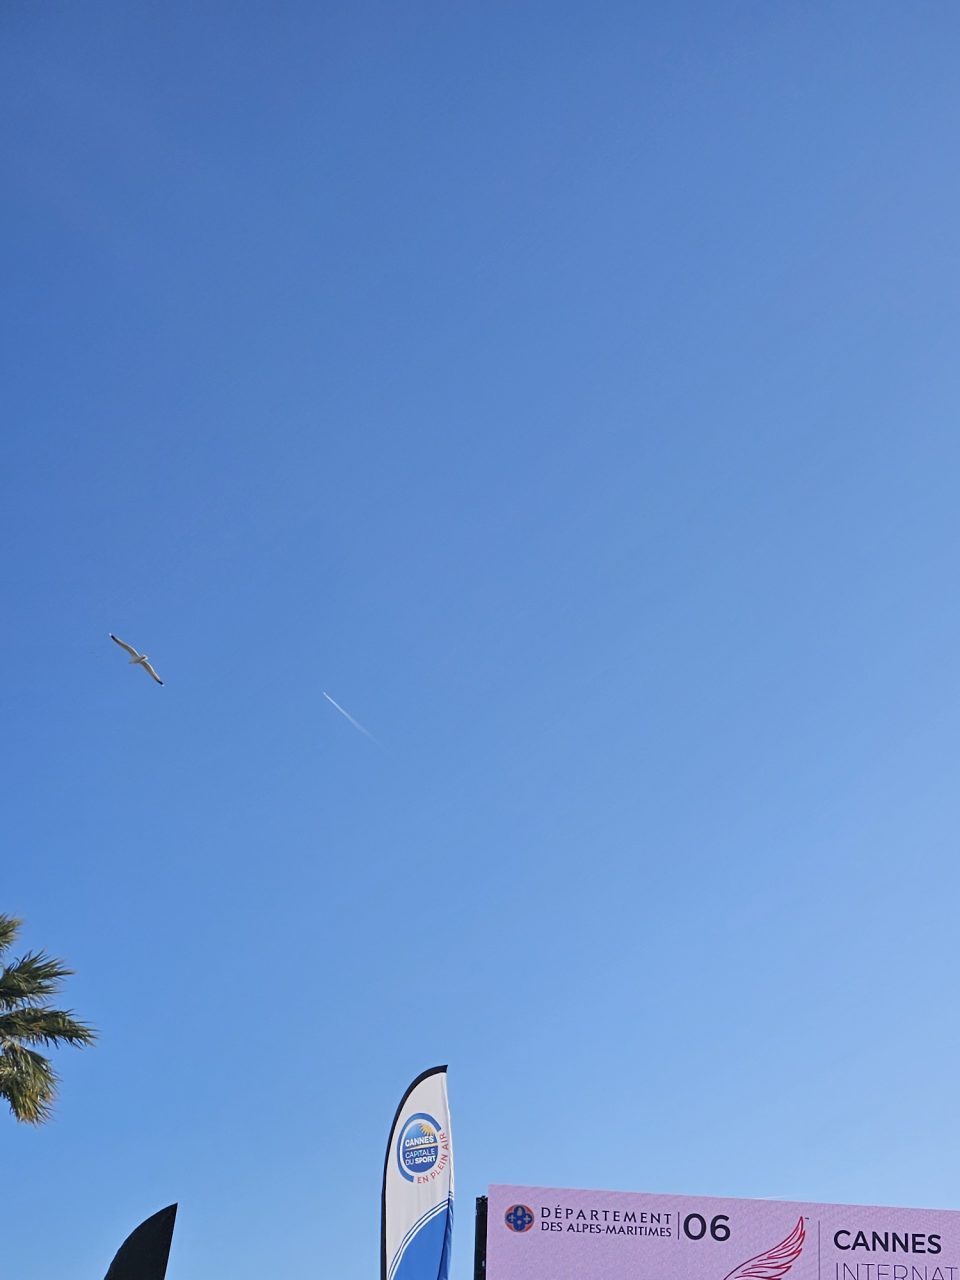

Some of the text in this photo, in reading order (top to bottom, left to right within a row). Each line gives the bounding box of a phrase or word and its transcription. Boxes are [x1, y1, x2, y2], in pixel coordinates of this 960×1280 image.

[405, 1136, 434, 1147] CANNES
[405, 1148, 435, 1159] CAPITALE
[415, 1156, 436, 1164] SPORT
[417, 1133, 449, 1184] EN PLEIN AIR
[541, 1205, 731, 1242] DÉPARTEMENT 06
[541, 1221, 672, 1237] DES ALPES-MARITIMES
[833, 1229, 942, 1254] CANNES
